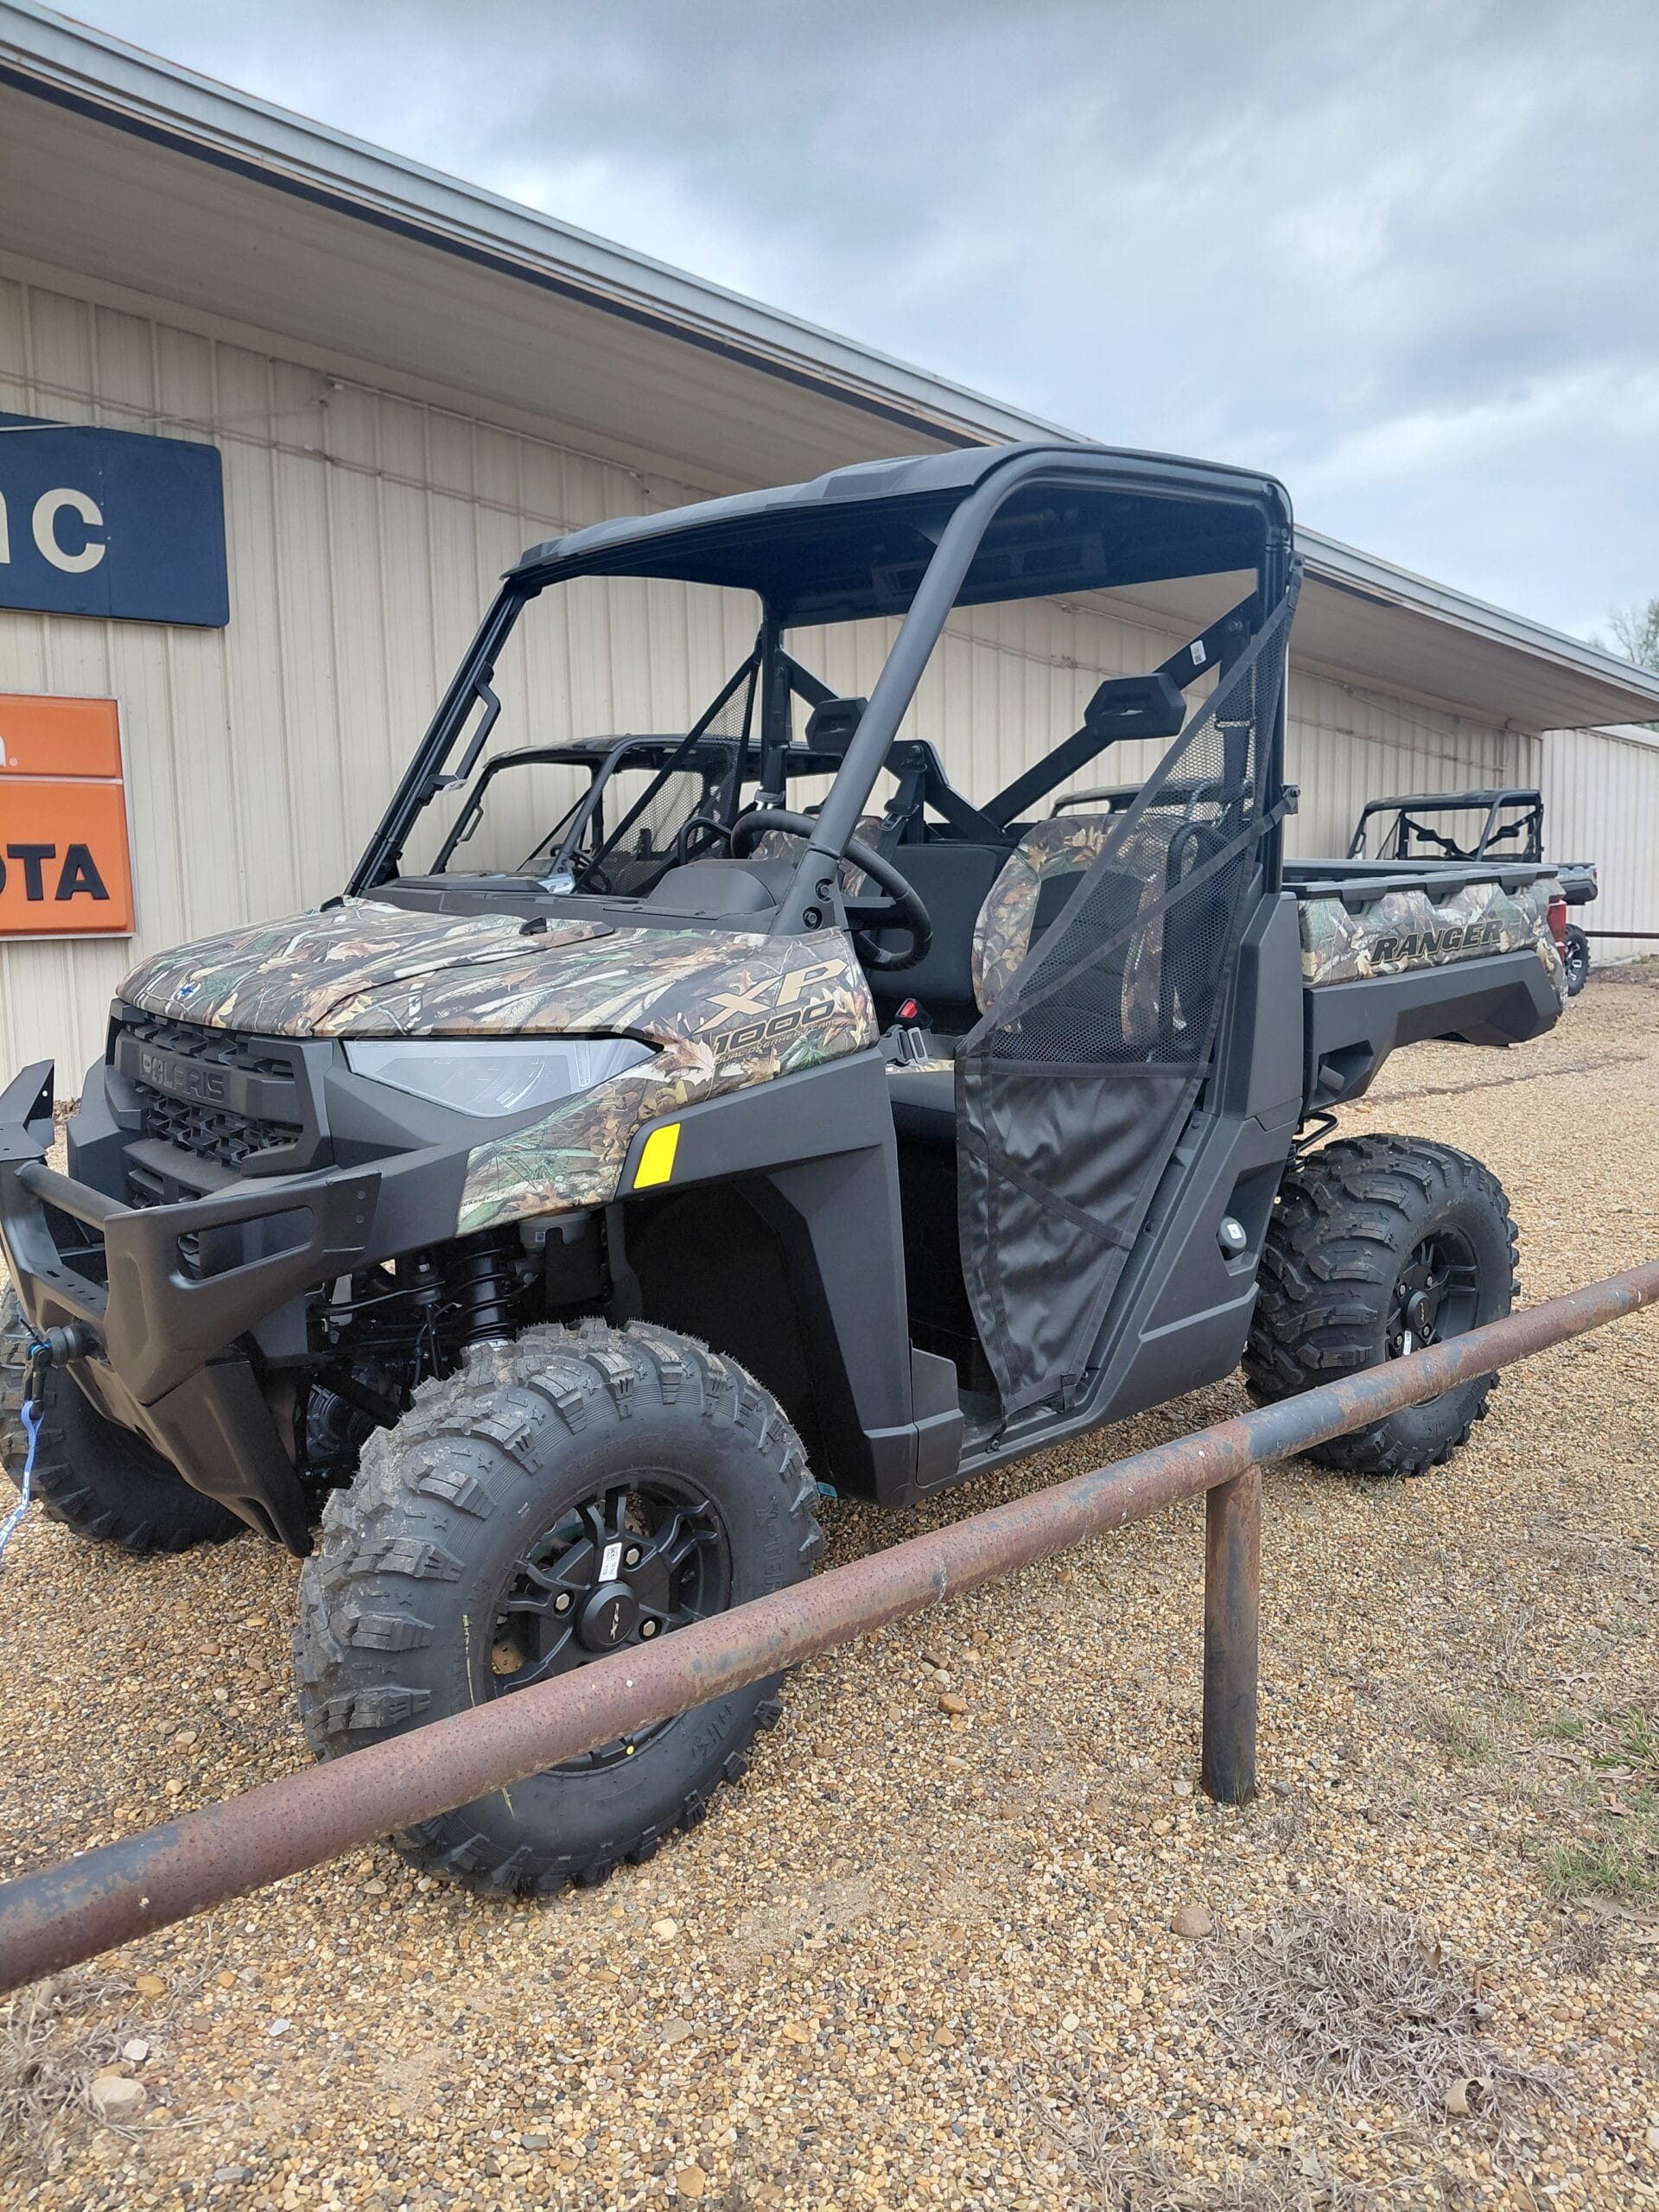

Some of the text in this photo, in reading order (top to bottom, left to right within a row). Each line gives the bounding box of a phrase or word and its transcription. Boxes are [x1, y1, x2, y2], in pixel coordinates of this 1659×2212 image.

[0, 843, 111, 900] TA
[1370, 919, 1504, 966] RANGER
[692, 957, 849, 1035] XP
[714, 1000, 836, 1057] 1000
[142, 1052, 226, 1103] POLARIS
